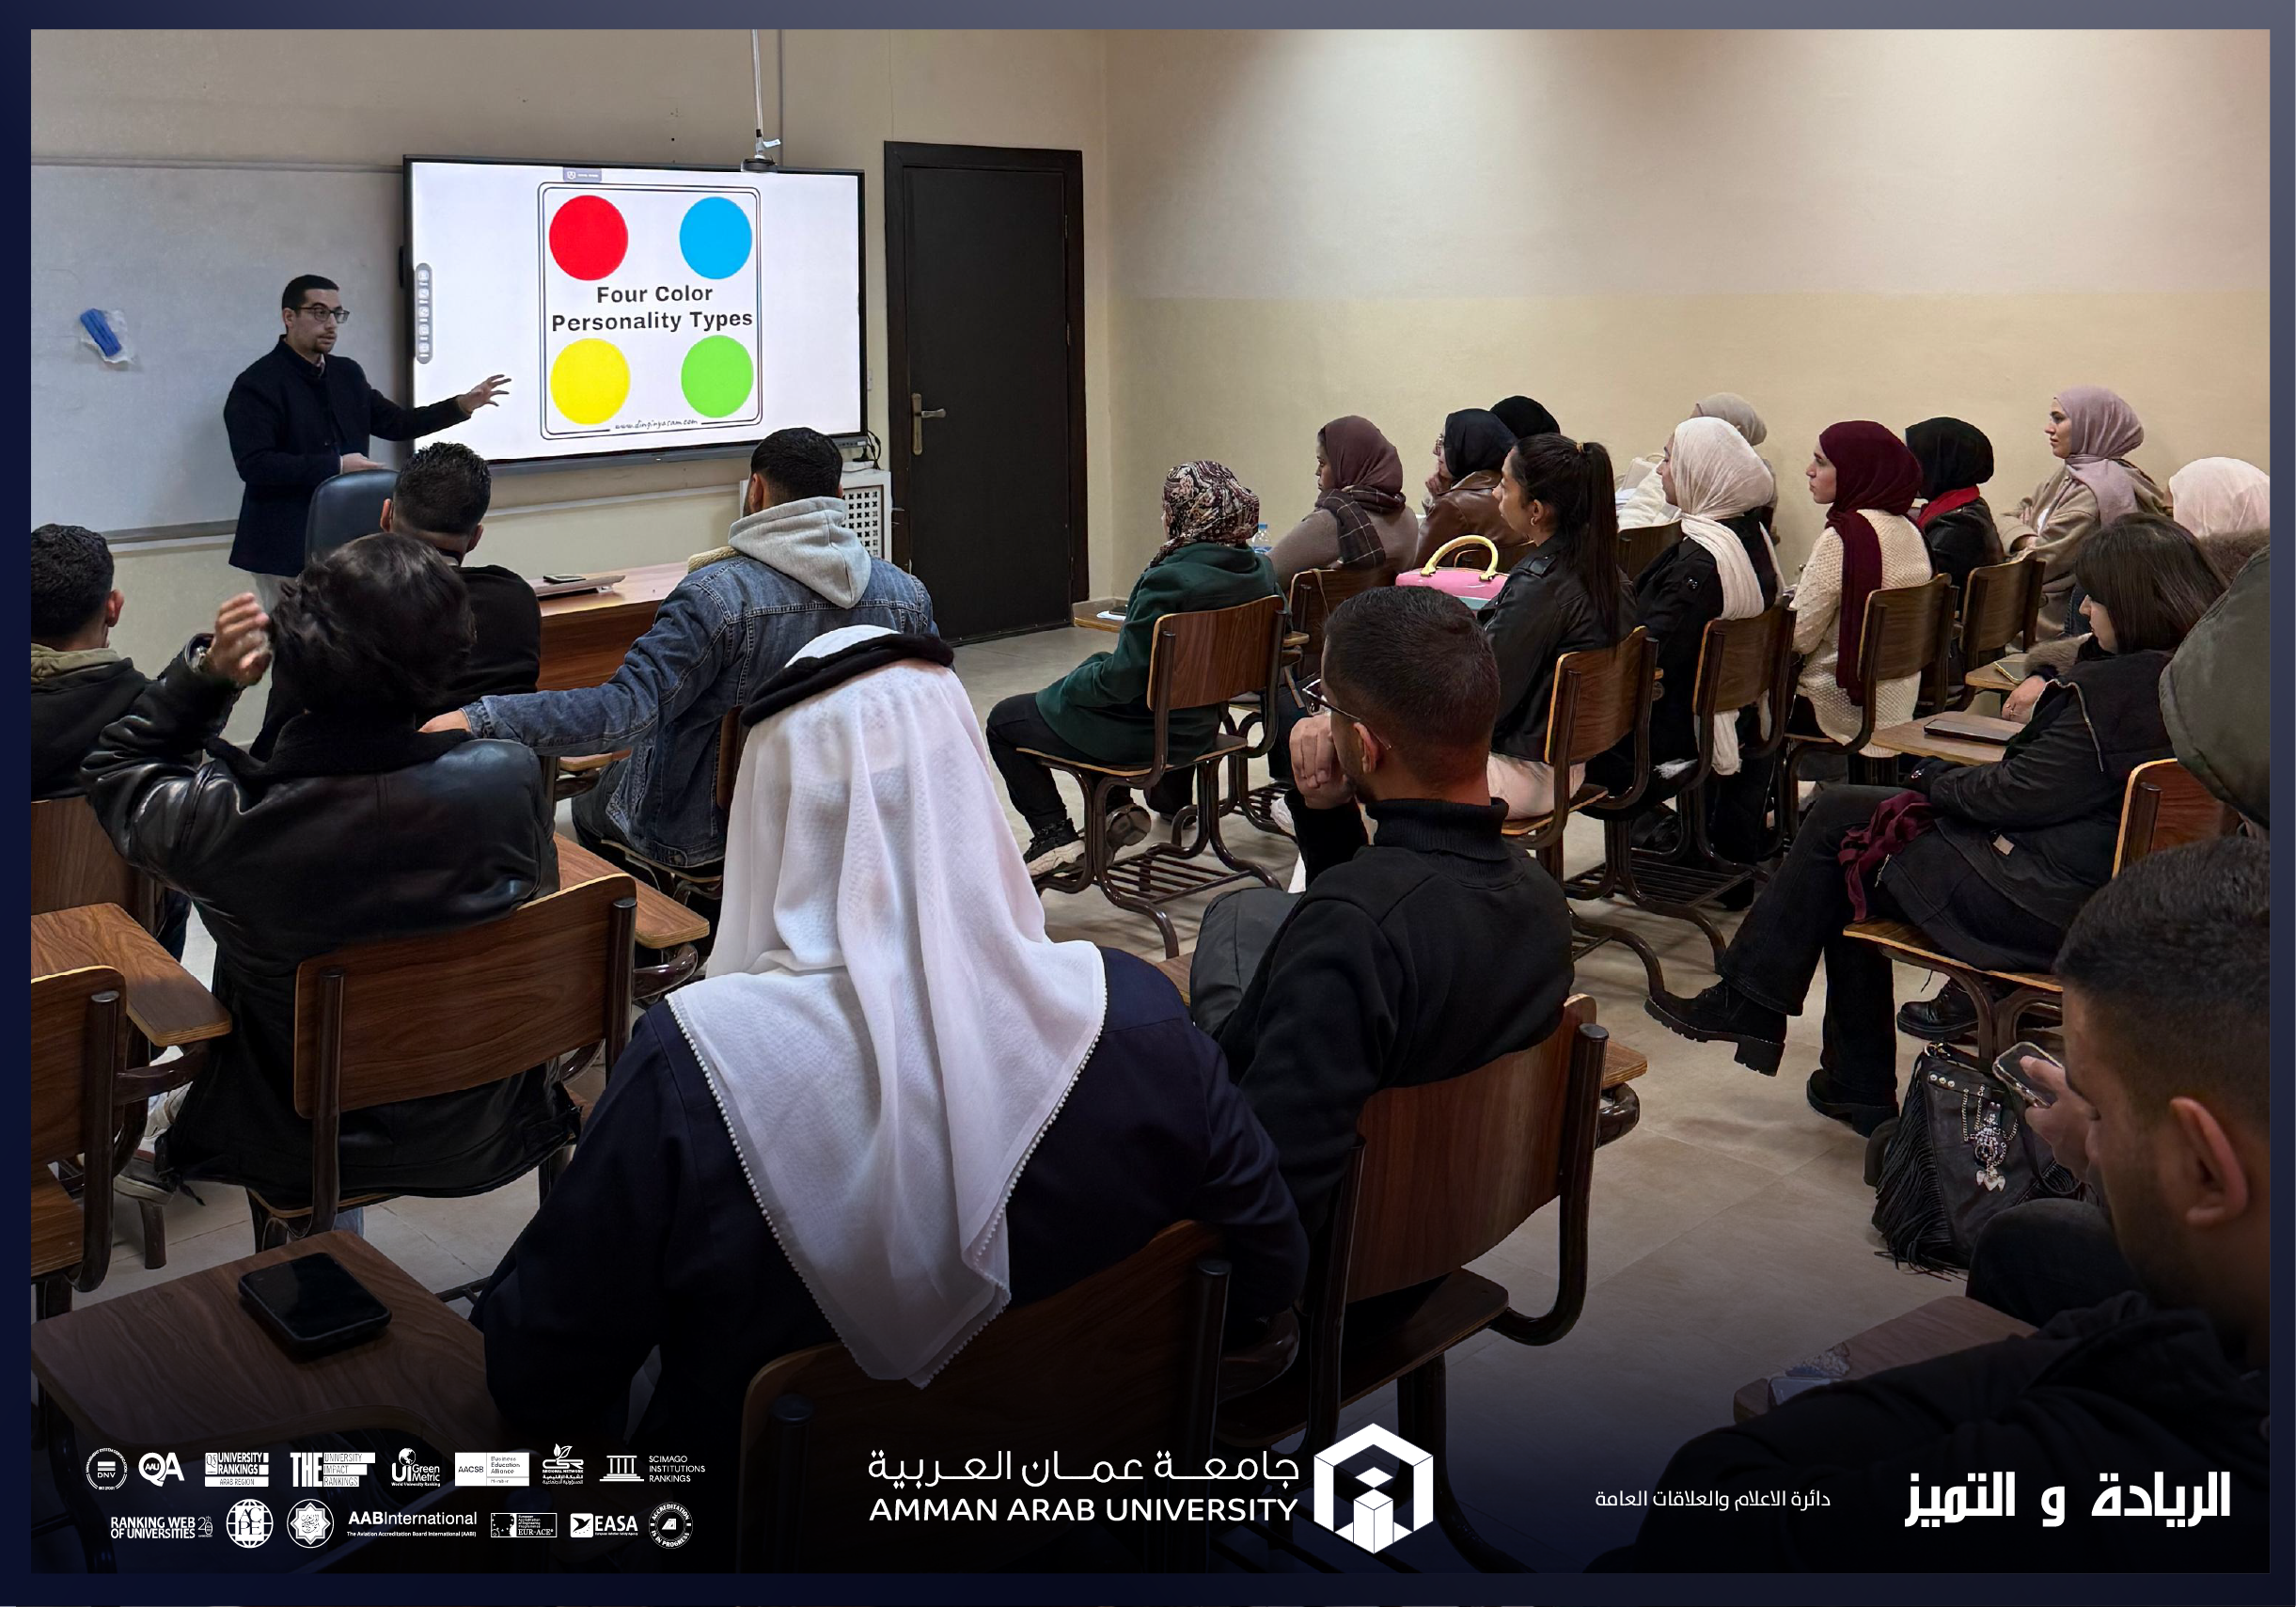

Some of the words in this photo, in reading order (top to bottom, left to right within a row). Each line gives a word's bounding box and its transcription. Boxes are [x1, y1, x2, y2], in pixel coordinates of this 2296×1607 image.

[598, 287, 647, 303] Four
[655, 285, 713, 301] Color
[553, 311, 681, 332] Personality
[690, 311, 752, 331] Types
